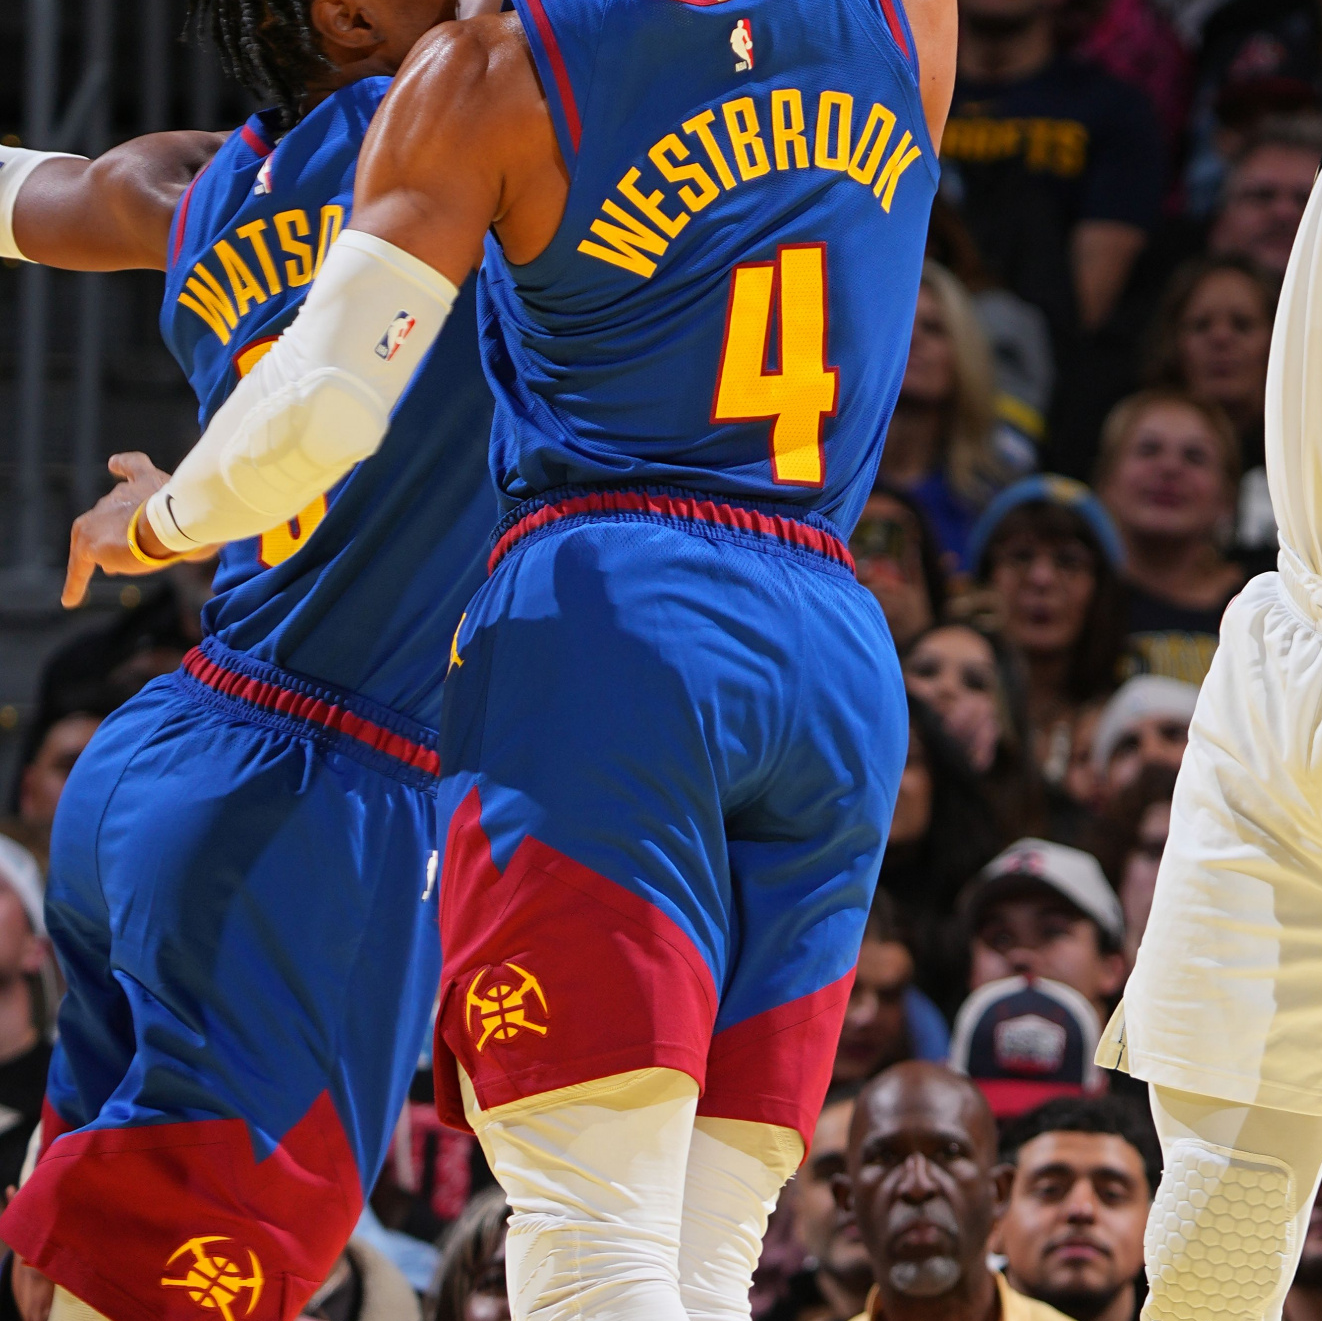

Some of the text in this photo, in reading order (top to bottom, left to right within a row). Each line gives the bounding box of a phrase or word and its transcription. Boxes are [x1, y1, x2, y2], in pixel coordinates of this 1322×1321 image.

[177, 204, 345, 346] WATSO
[577, 88, 922, 279] WESTBROOK
[710, 241, 840, 489] 4
